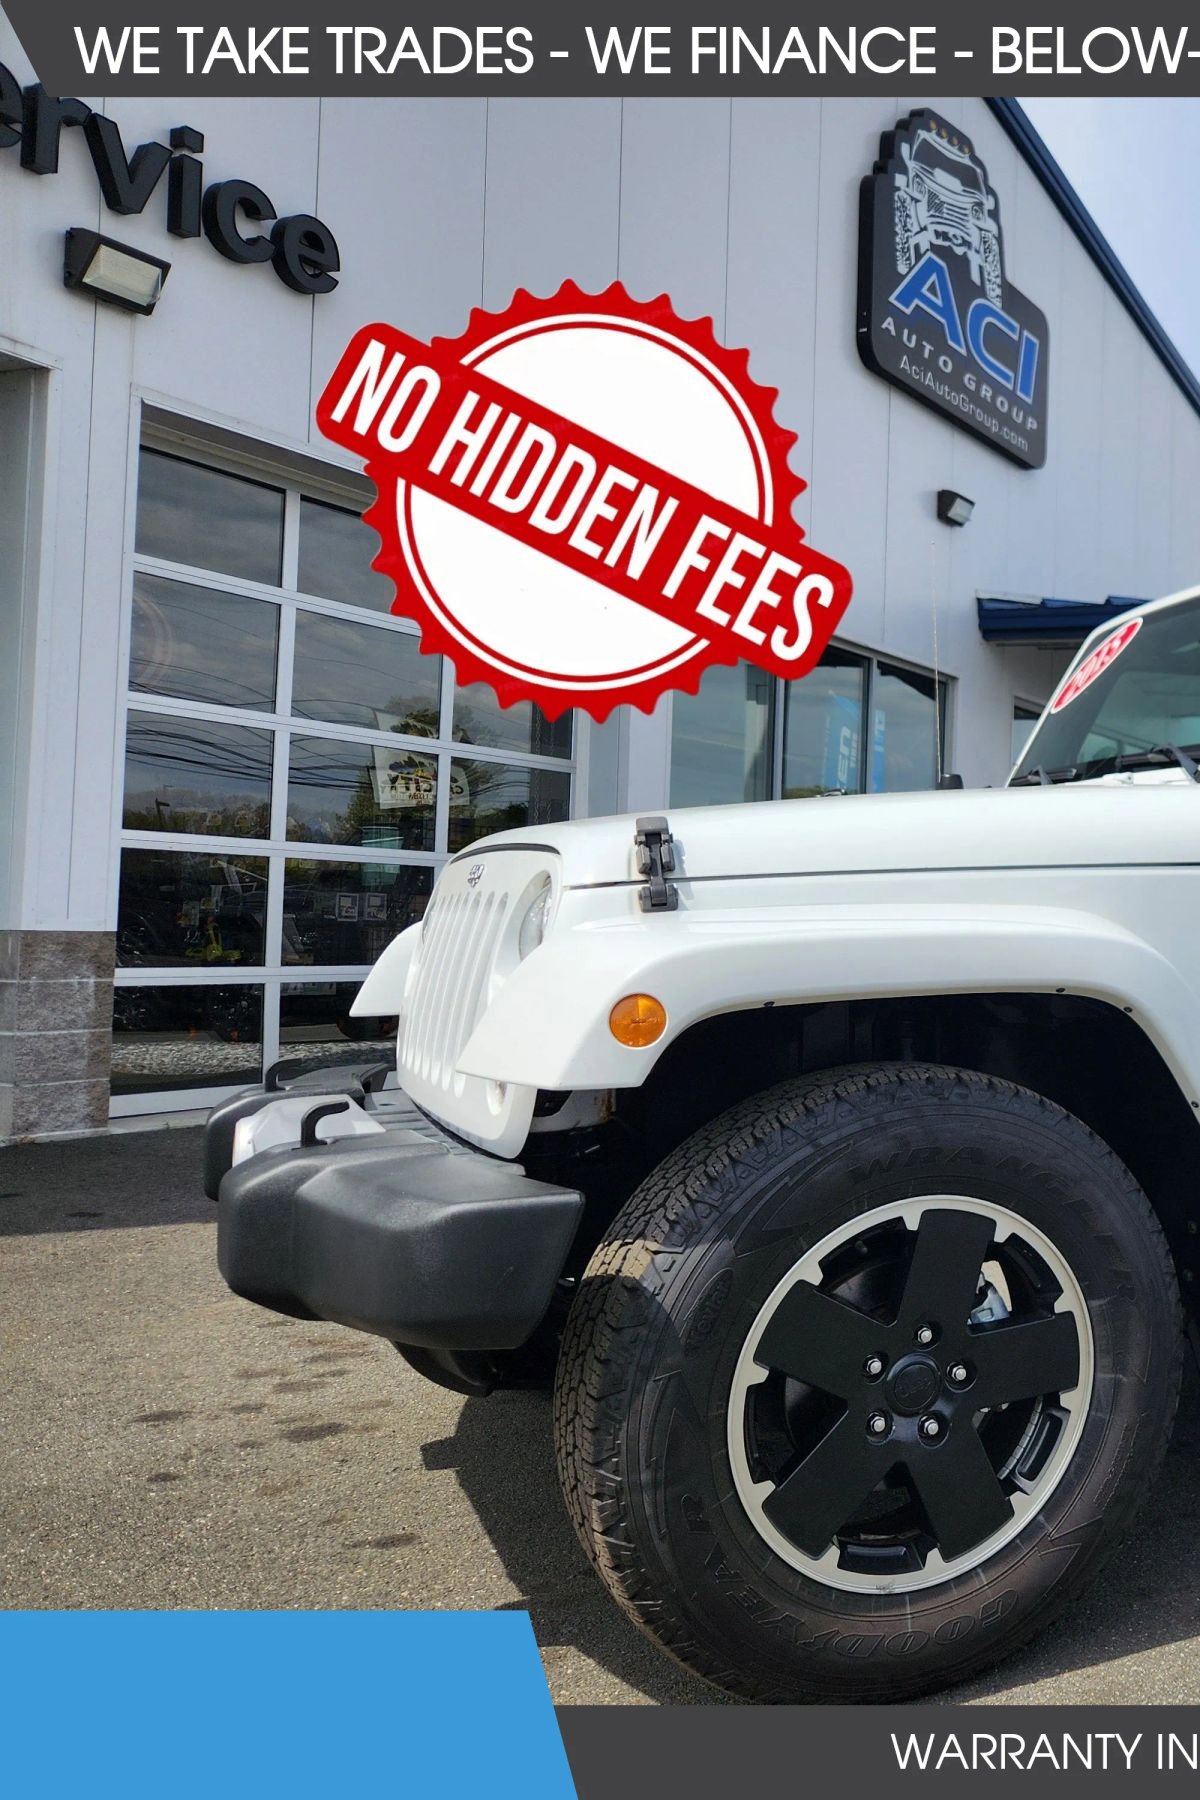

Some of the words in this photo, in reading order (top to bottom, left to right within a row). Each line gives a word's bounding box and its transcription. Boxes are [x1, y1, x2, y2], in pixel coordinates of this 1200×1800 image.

[881, 316, 953, 373] AUTO
[963, 371, 1038, 431] GROUP
[889, 251, 1040, 405] ACI
[900, 354, 1029, 452] AciAutoGroup.com
[679, 1491, 1018, 1659] GOODYEAR
